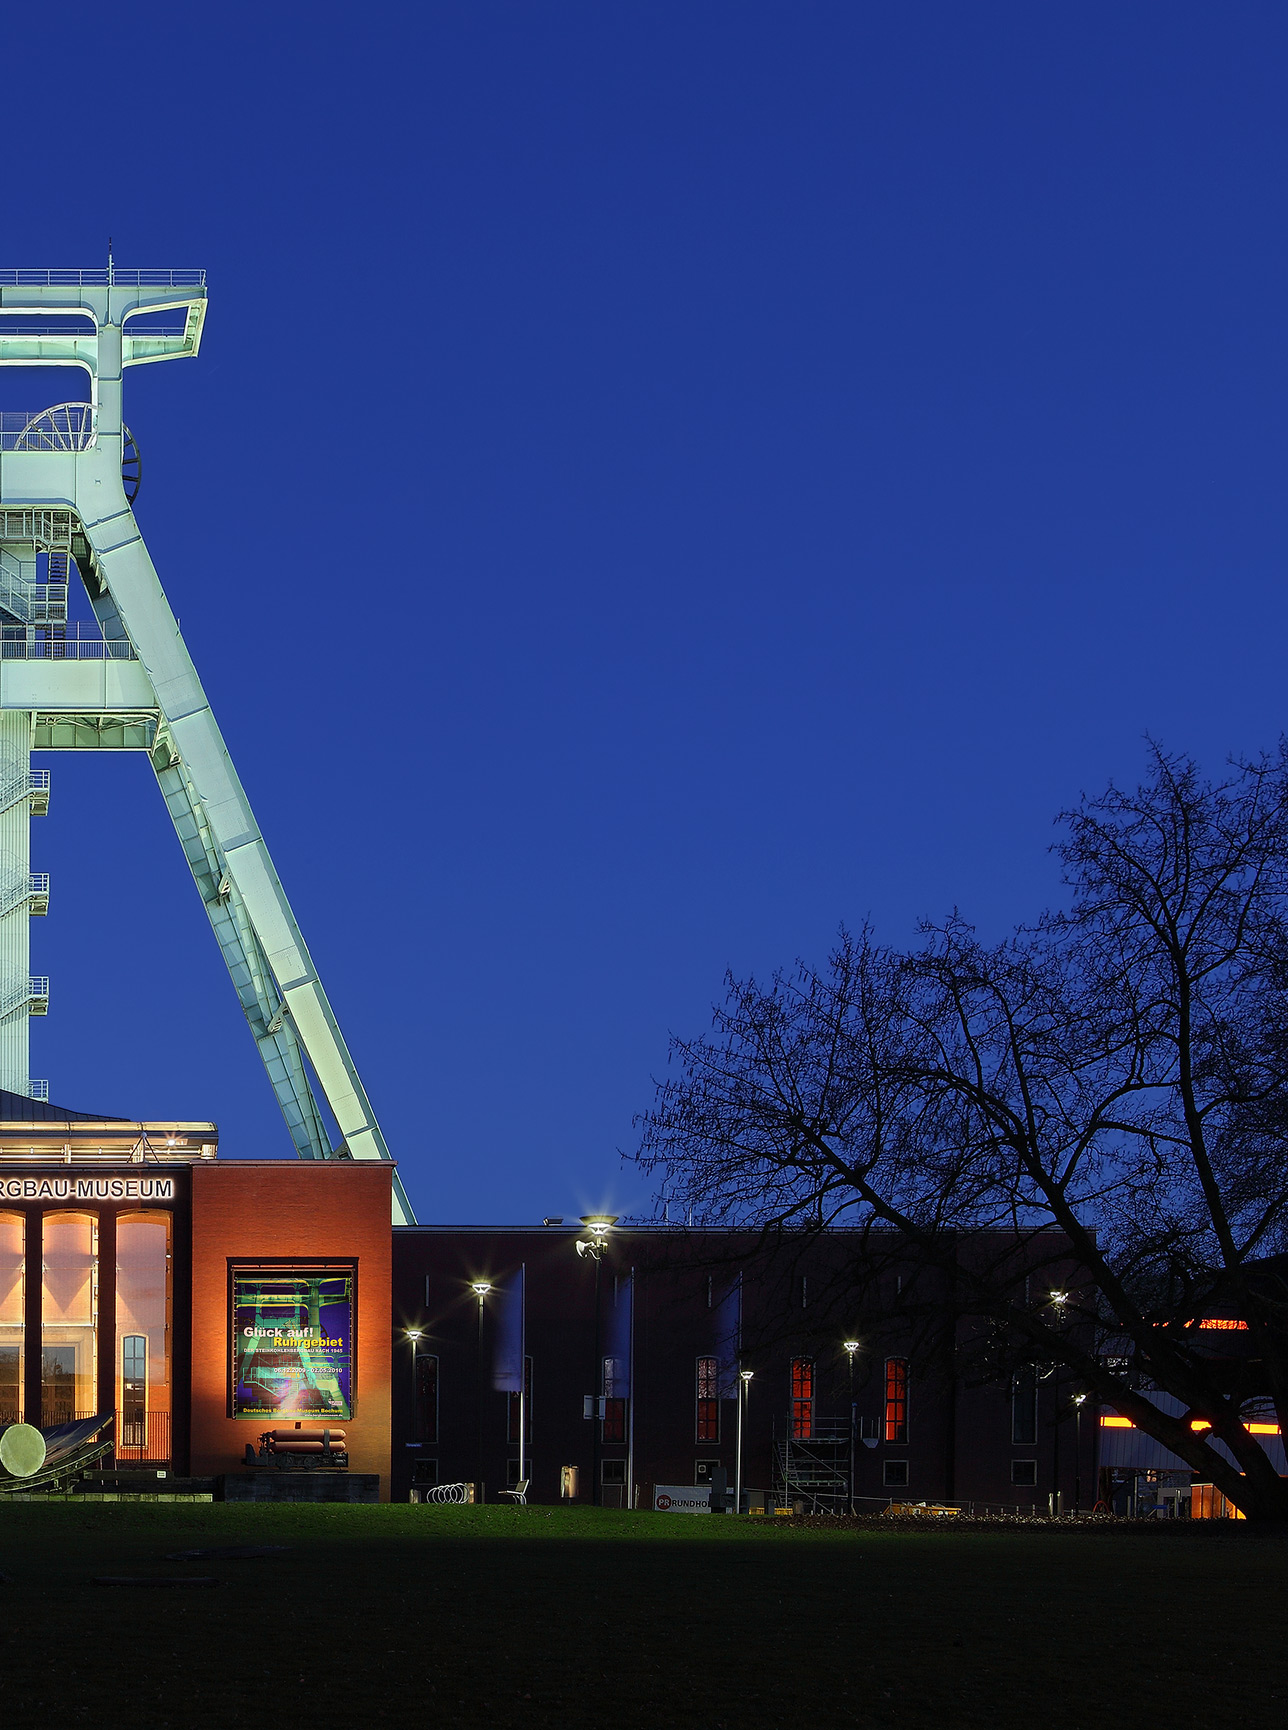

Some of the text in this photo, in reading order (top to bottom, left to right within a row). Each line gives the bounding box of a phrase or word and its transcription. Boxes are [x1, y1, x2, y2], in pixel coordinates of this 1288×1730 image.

[243, 1326, 314, 1338] Glück auf!
[273, 1337, 343, 1349] Ruhrgebiet
[658, 1498, 670, 1506] PR
